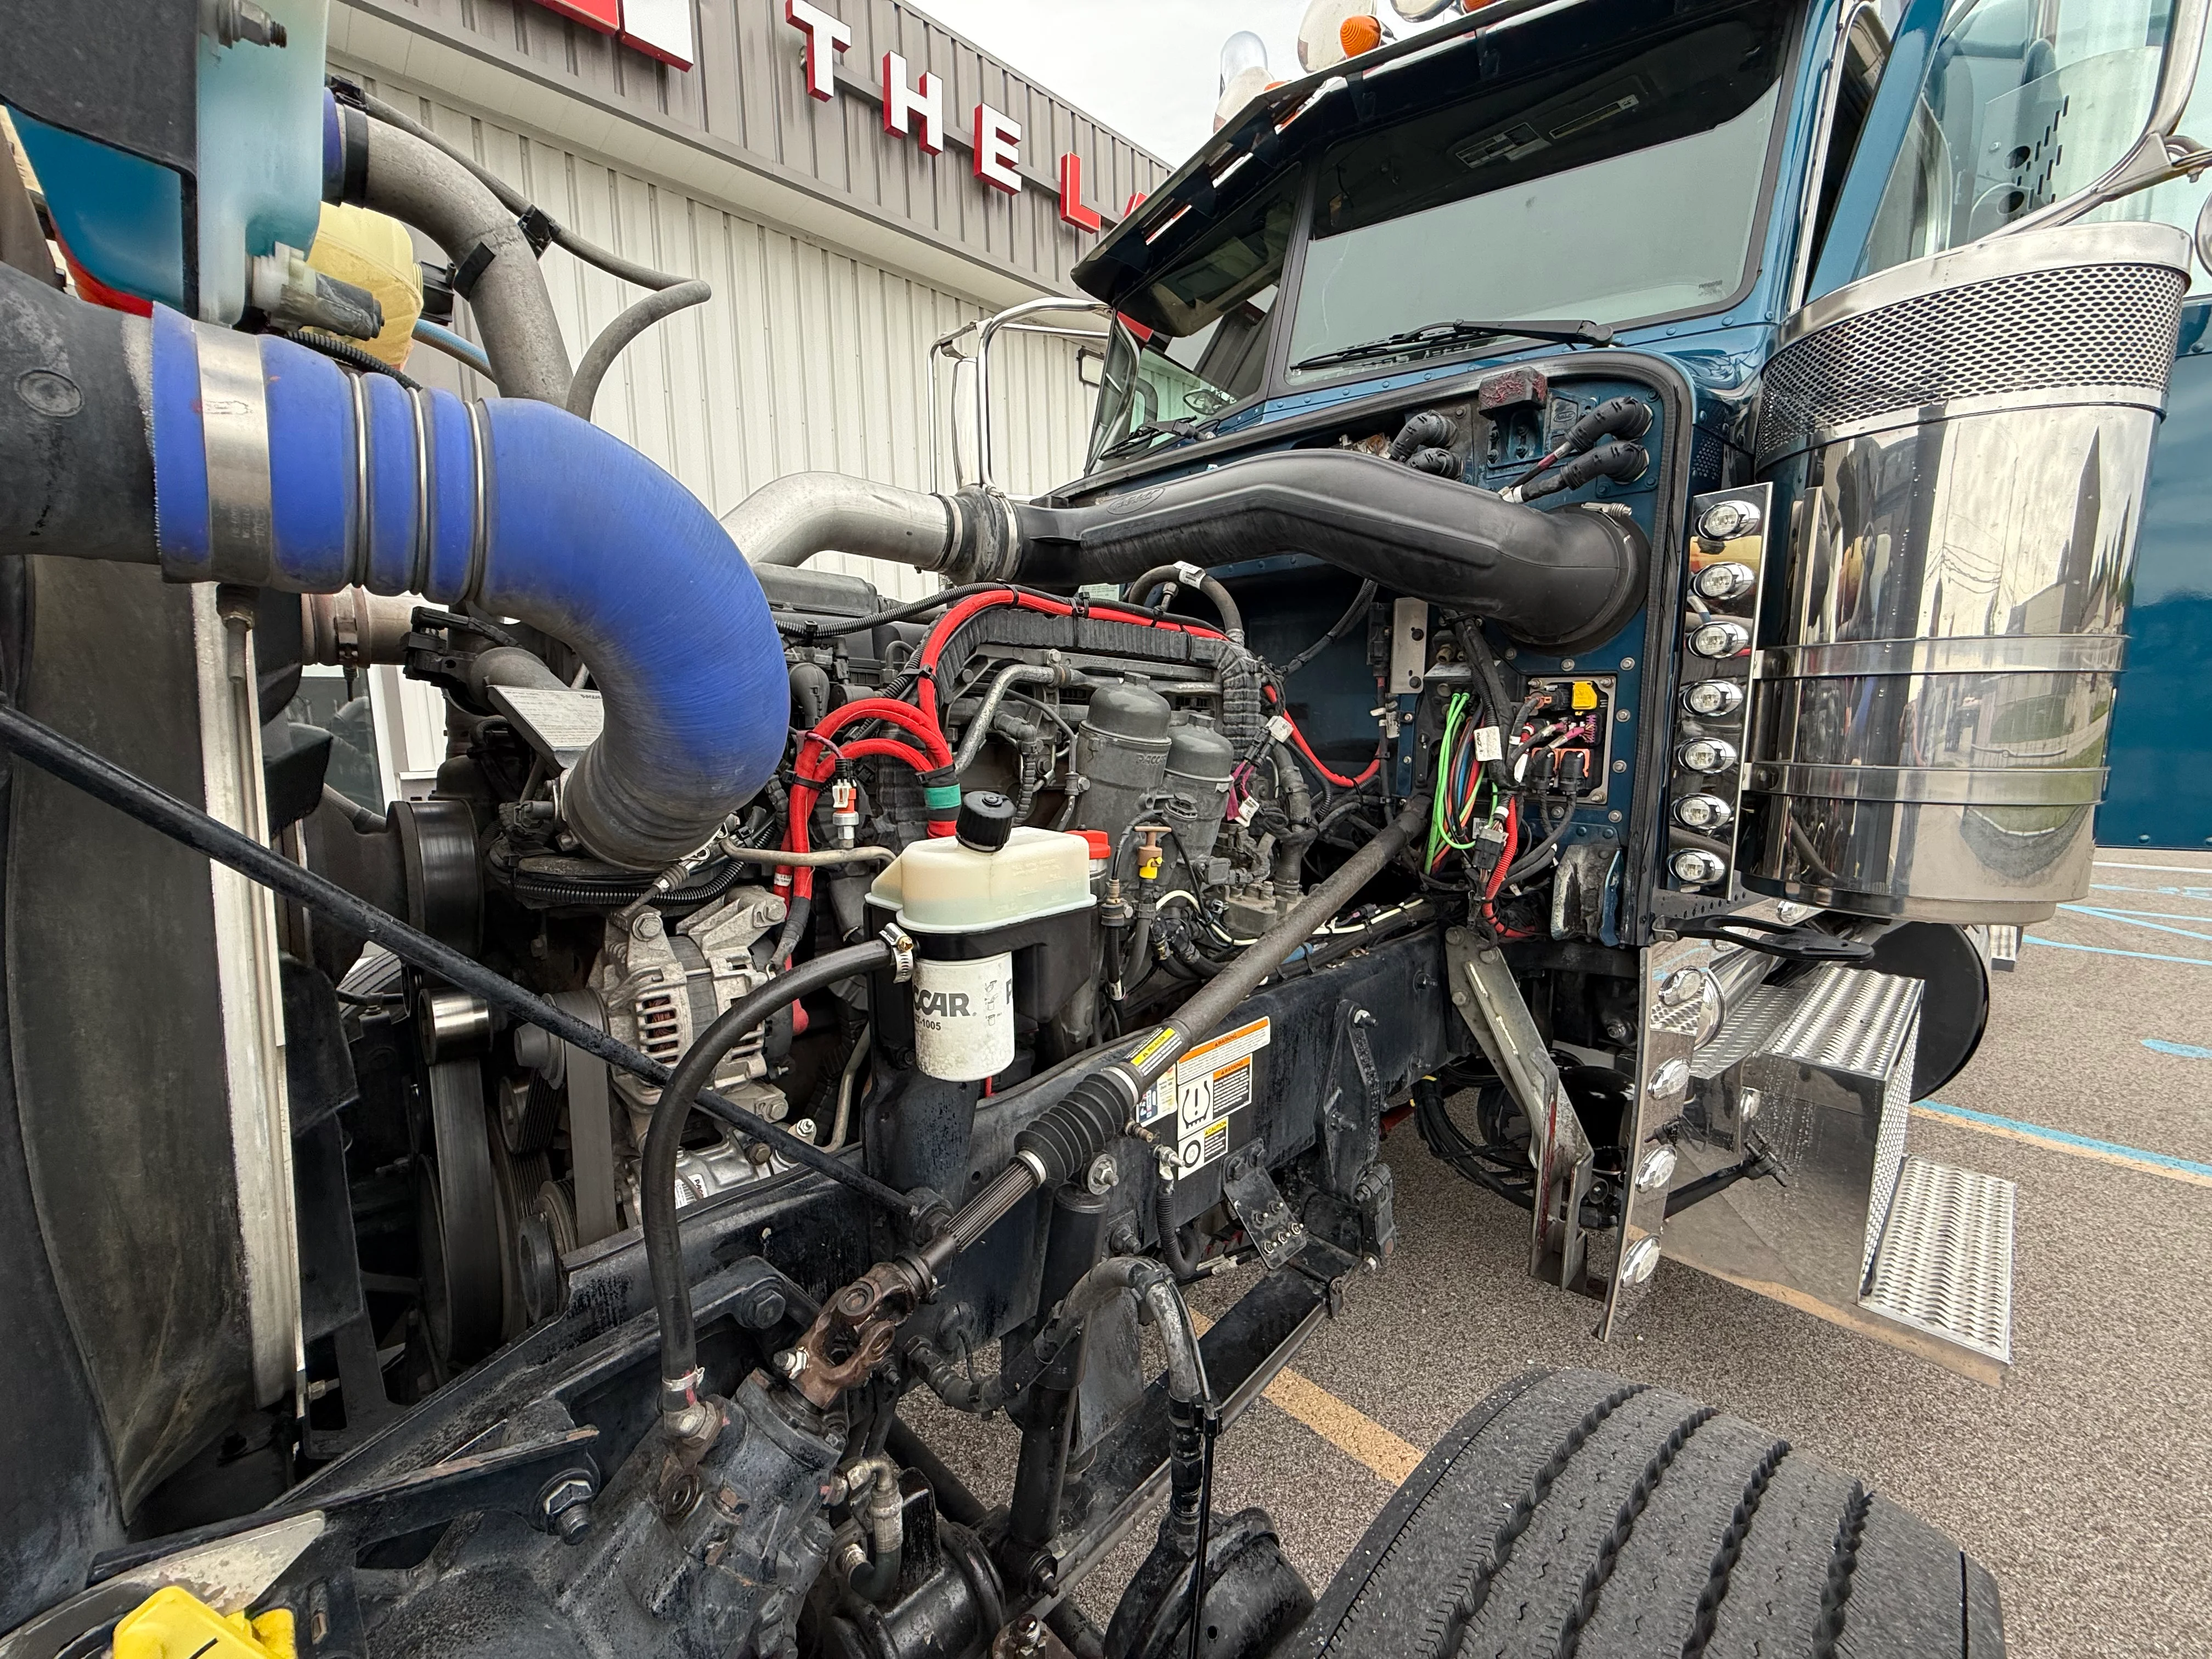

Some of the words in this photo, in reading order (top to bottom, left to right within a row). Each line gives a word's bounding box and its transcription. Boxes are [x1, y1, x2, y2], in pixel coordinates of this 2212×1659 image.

[786, 0, 1022, 196] THE
[1217, 1034, 1237, 1045] WARNING
[1223, 1061, 1244, 1074] WARNING
[1208, 1120, 1227, 1133] CAUTION
